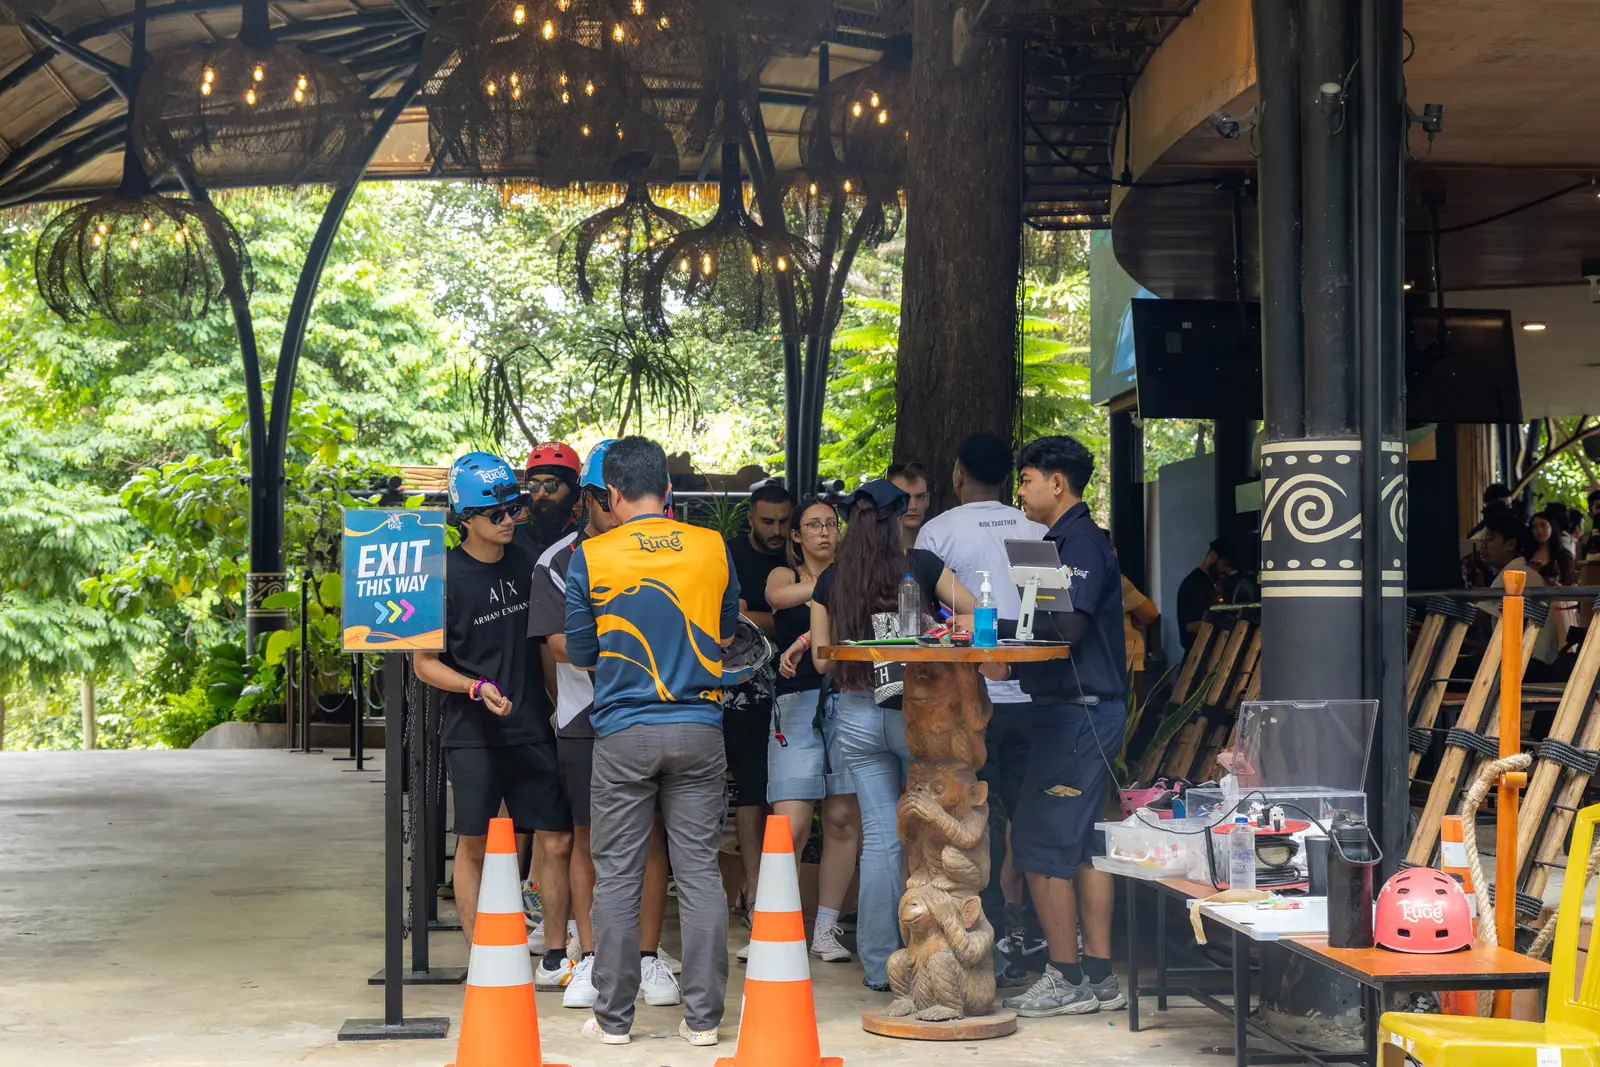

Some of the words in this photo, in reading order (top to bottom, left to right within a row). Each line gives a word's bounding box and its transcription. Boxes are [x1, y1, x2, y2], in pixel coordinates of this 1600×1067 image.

[991, 519, 1017, 527] TOGETHER
[357, 539, 431, 578] EXIT
[356, 578, 392, 597] THIS
[395, 574, 429, 593] WAY
